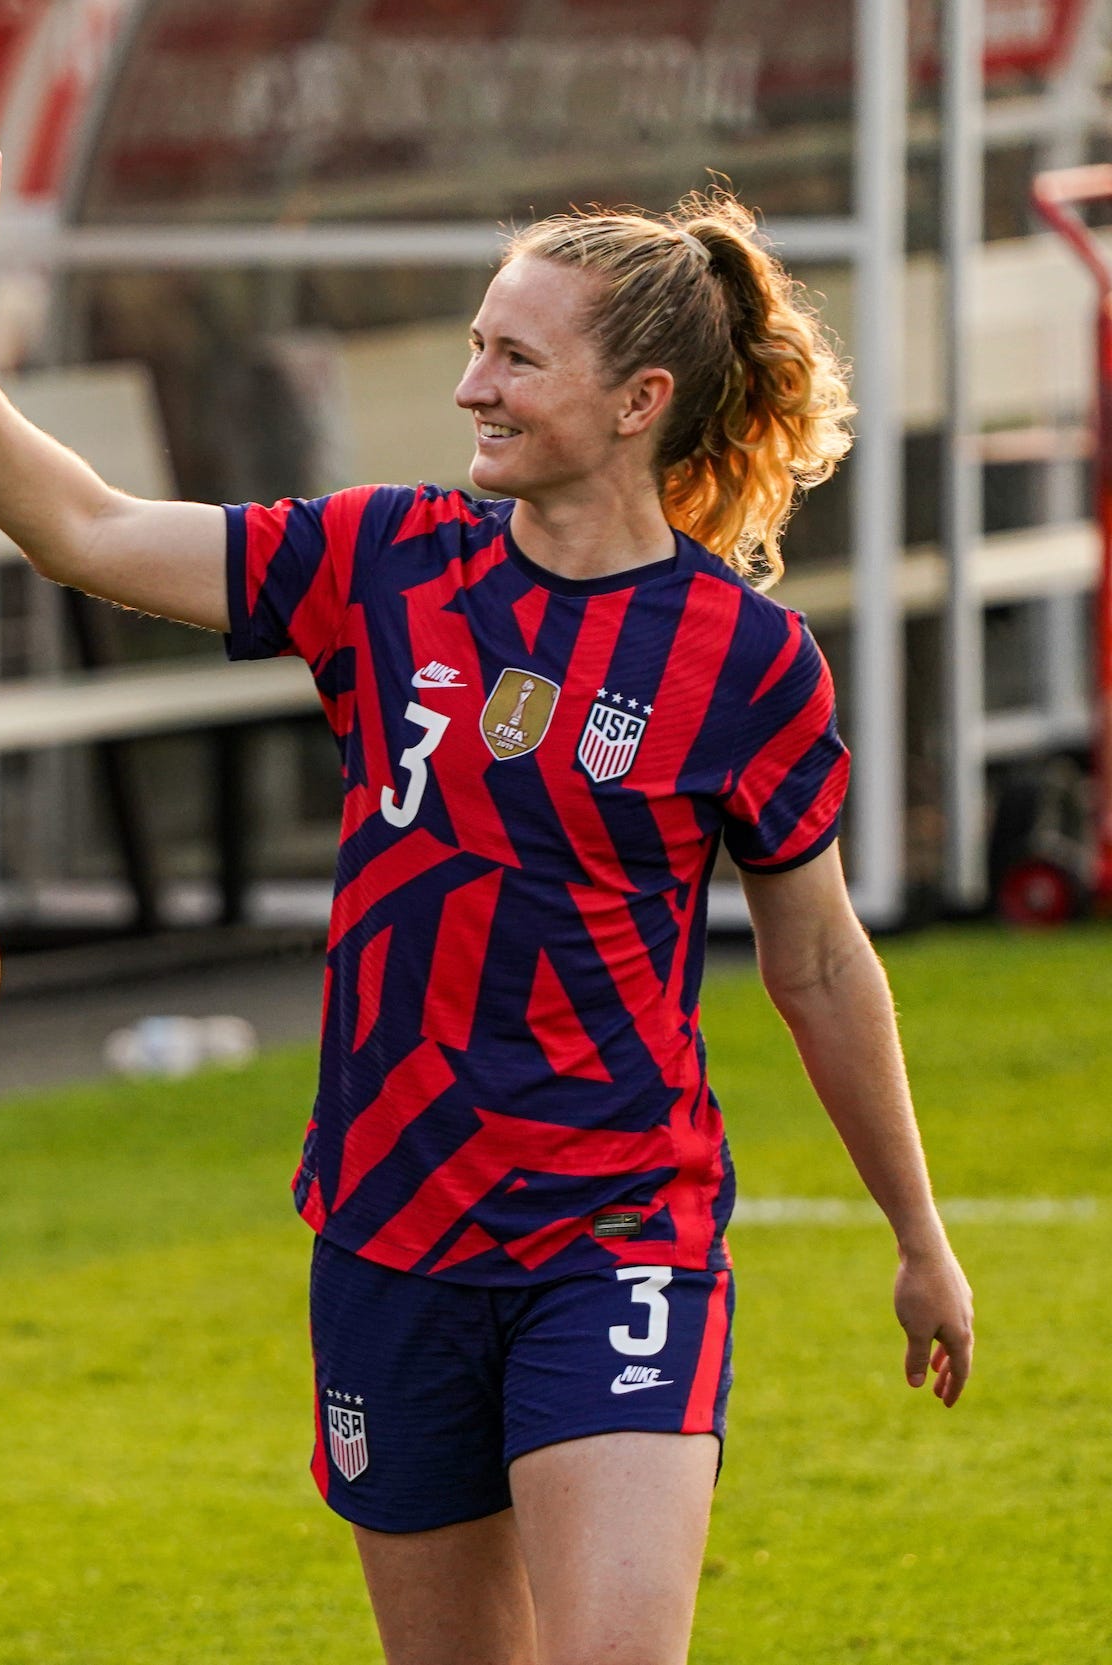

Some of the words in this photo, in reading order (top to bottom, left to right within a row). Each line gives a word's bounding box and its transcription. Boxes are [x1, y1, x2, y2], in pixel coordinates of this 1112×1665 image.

[420, 660, 461, 682] NIKE
[494, 723, 523, 742] FIFA
[592, 707, 642, 741] USA
[381, 701, 451, 828] 3
[608, 1265, 673, 1356] 3
[620, 1364, 662, 1383] NIKE
[330, 1408, 363, 1440] USA
